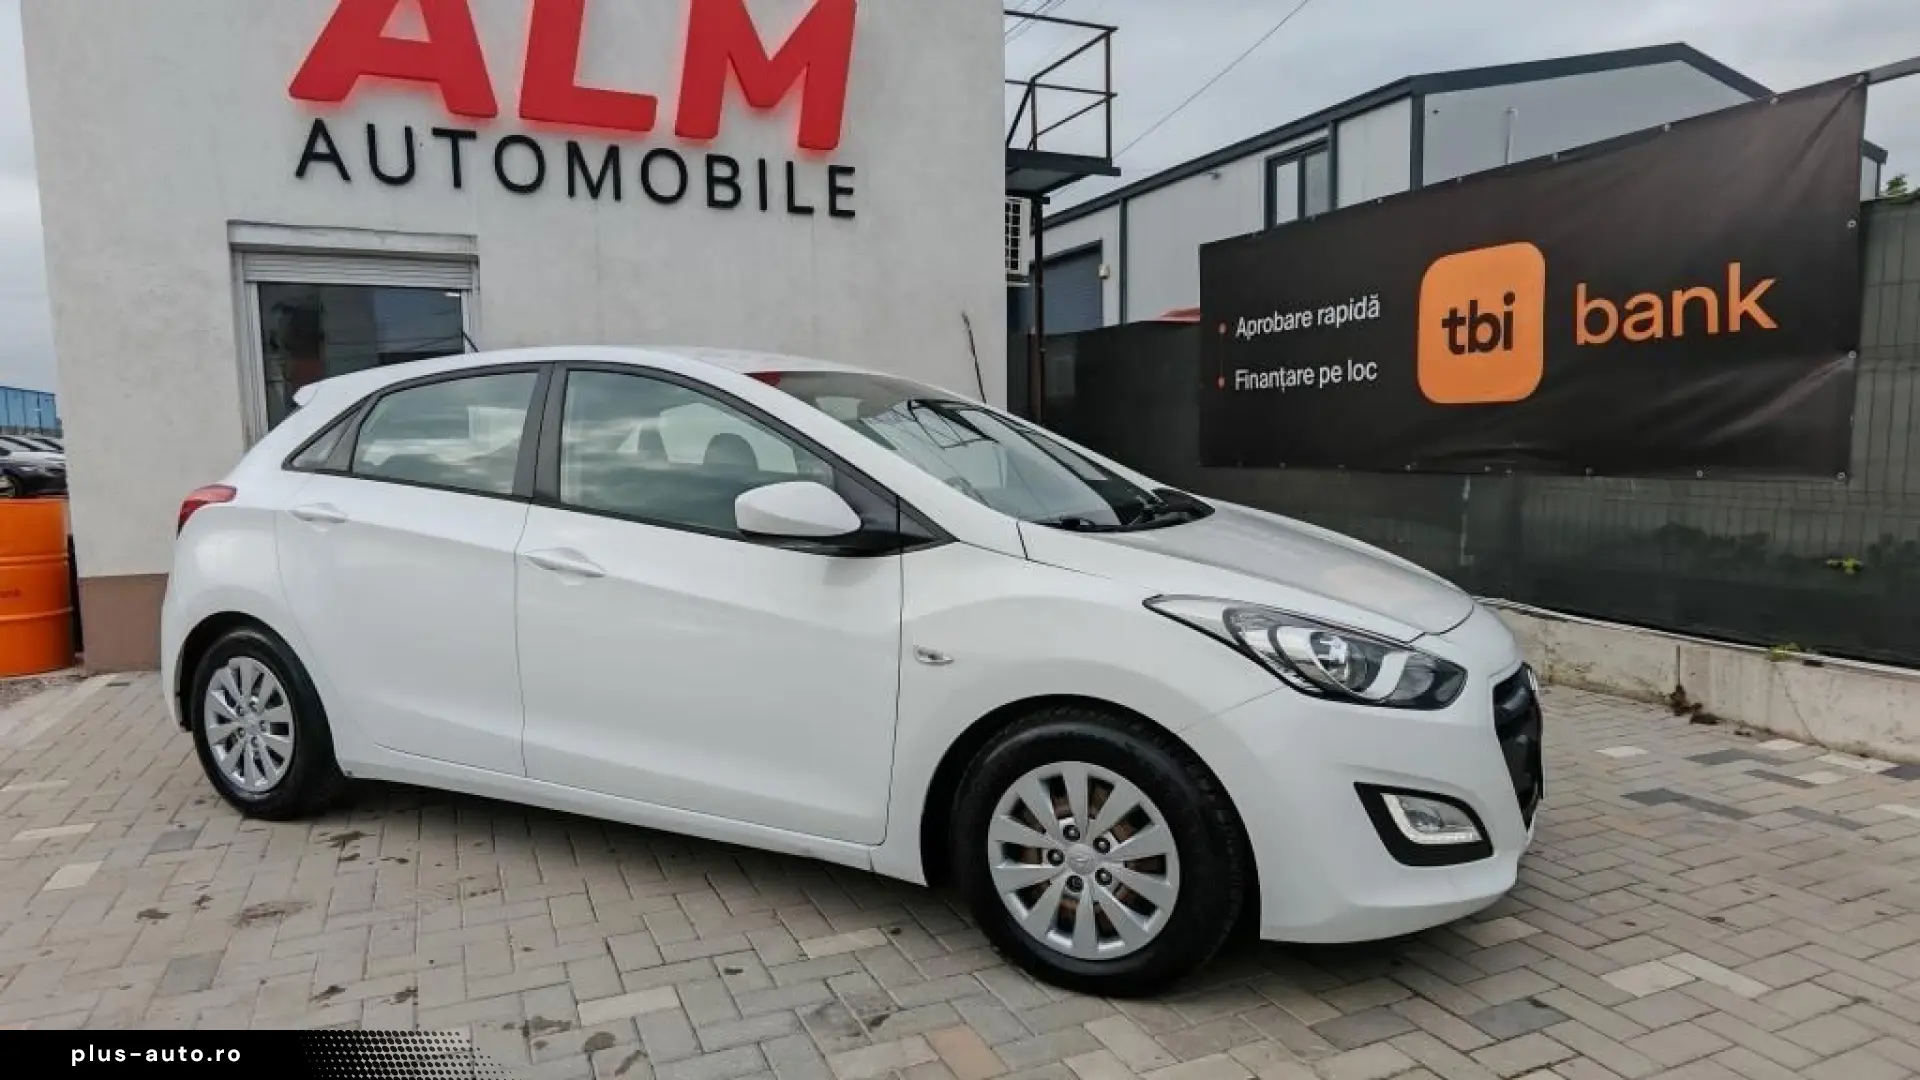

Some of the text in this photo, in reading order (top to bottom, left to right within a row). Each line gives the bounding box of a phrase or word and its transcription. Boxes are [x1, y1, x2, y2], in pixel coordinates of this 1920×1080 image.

[289, 0, 857, 151] ALM
[295, 117, 857, 219] AUTOMOBILE
[1235, 293, 1381, 340] Aprobare rapidă
[1441, 262, 1777, 356] tbi bank
[1235, 359, 1378, 393] Finanțare pe loc
